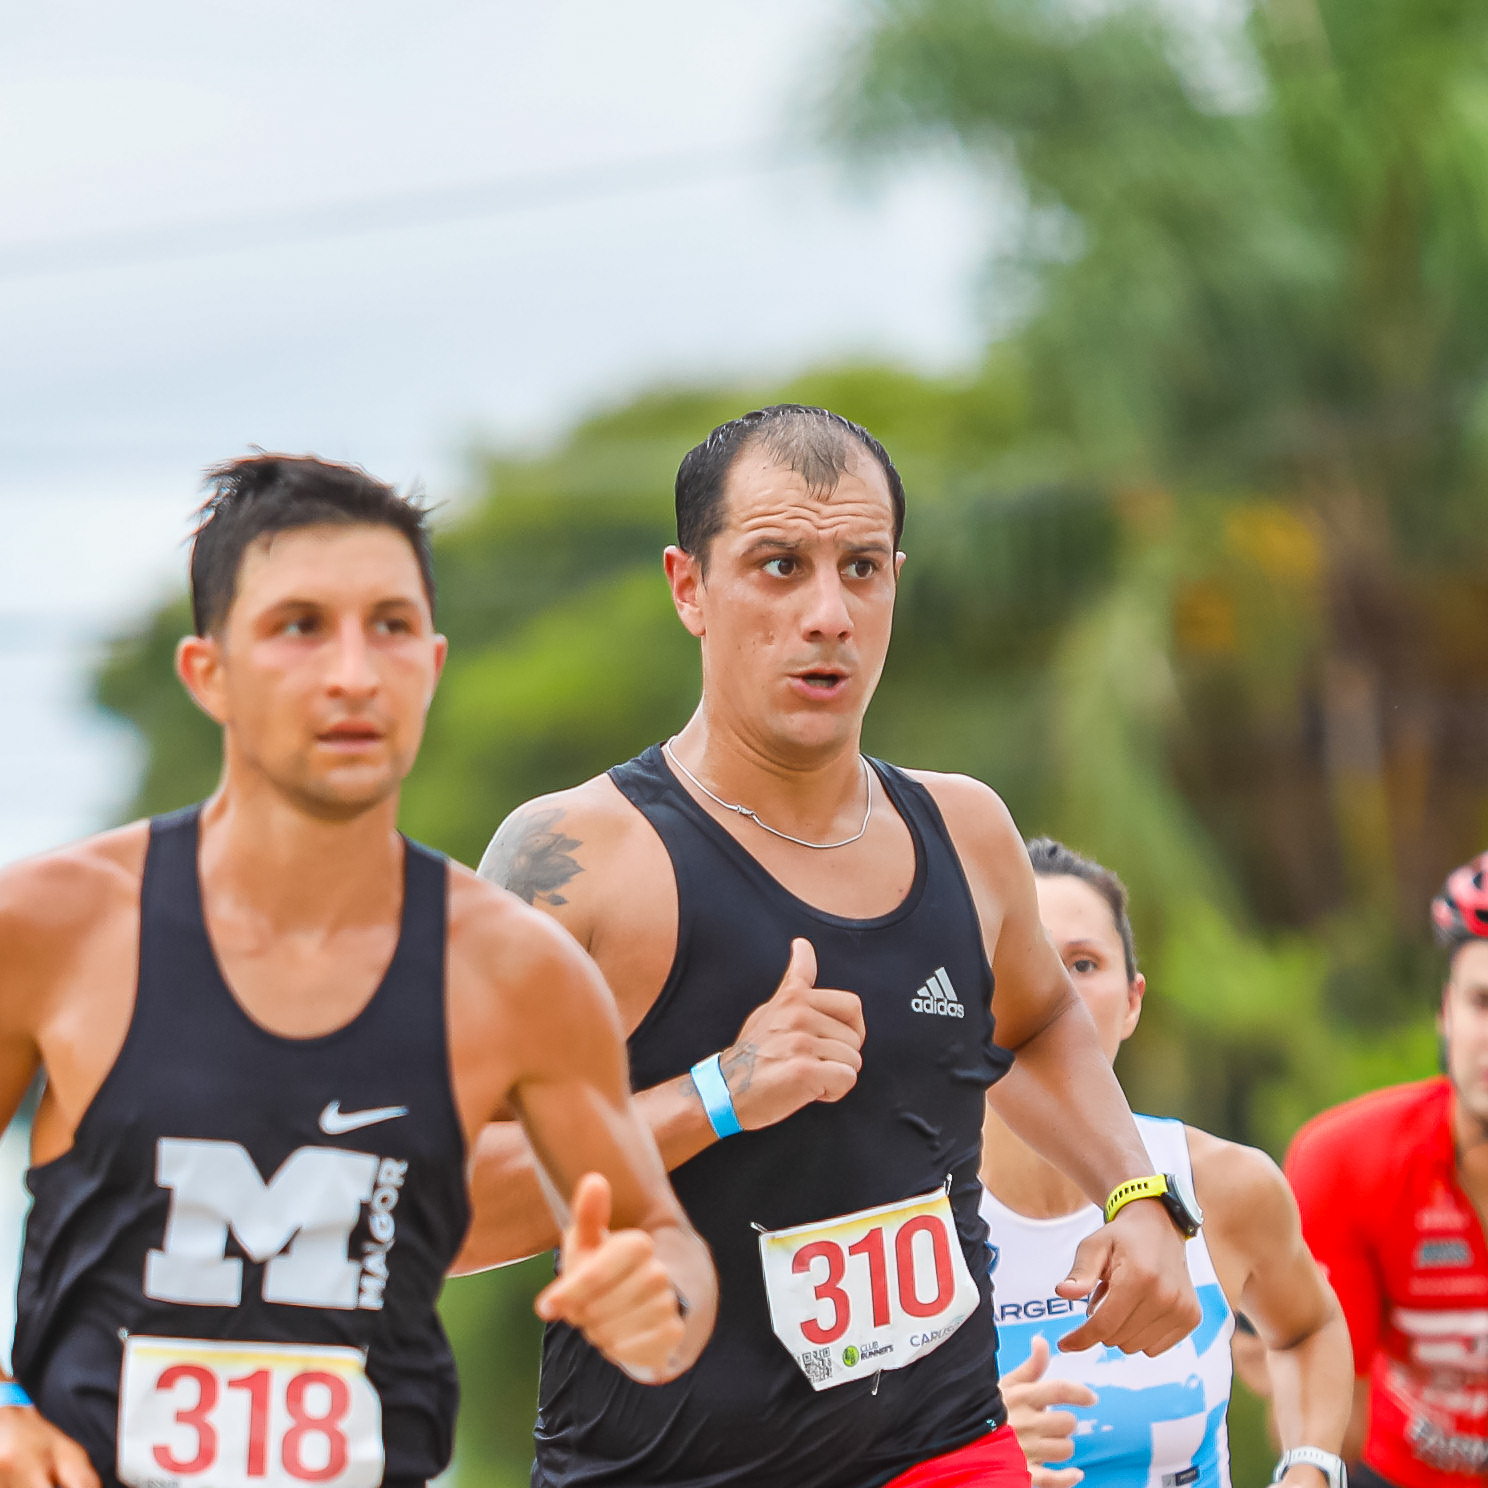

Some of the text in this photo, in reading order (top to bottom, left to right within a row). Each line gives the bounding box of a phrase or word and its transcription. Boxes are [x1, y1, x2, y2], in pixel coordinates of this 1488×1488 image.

[911, 995, 965, 1019] adidas
[145, 1136, 380, 1311] M
[791, 1214, 955, 1345] 310
[859, 1340, 879, 1353] CLUB
[909, 1324, 957, 1348] CARUS
[152, 1362, 354, 1482] 318
